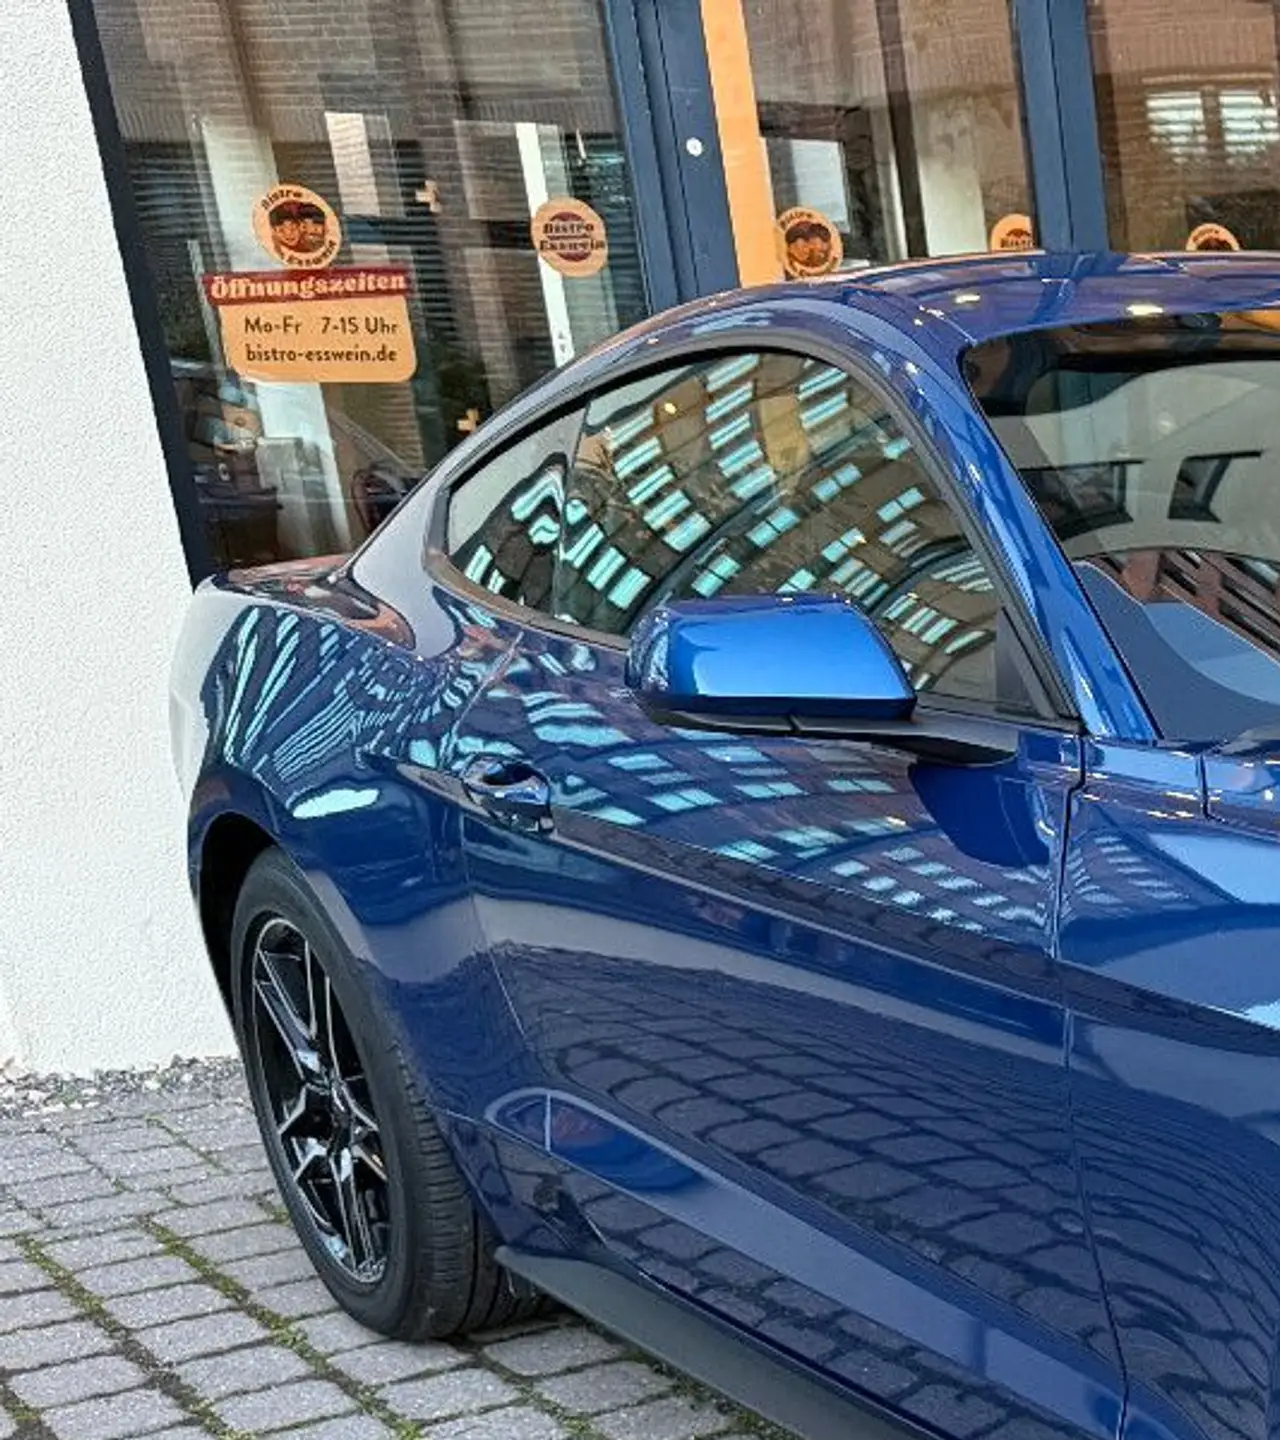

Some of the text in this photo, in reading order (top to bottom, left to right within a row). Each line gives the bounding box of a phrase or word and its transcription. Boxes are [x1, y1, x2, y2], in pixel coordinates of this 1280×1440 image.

[542, 222, 595, 234] Bistro
[210, 271, 407, 299] Öffnungszeiten
[244, 315, 399, 335] Mo-Fr 7-15 Uhr
[245, 342, 398, 362] bistro-esswein.de
